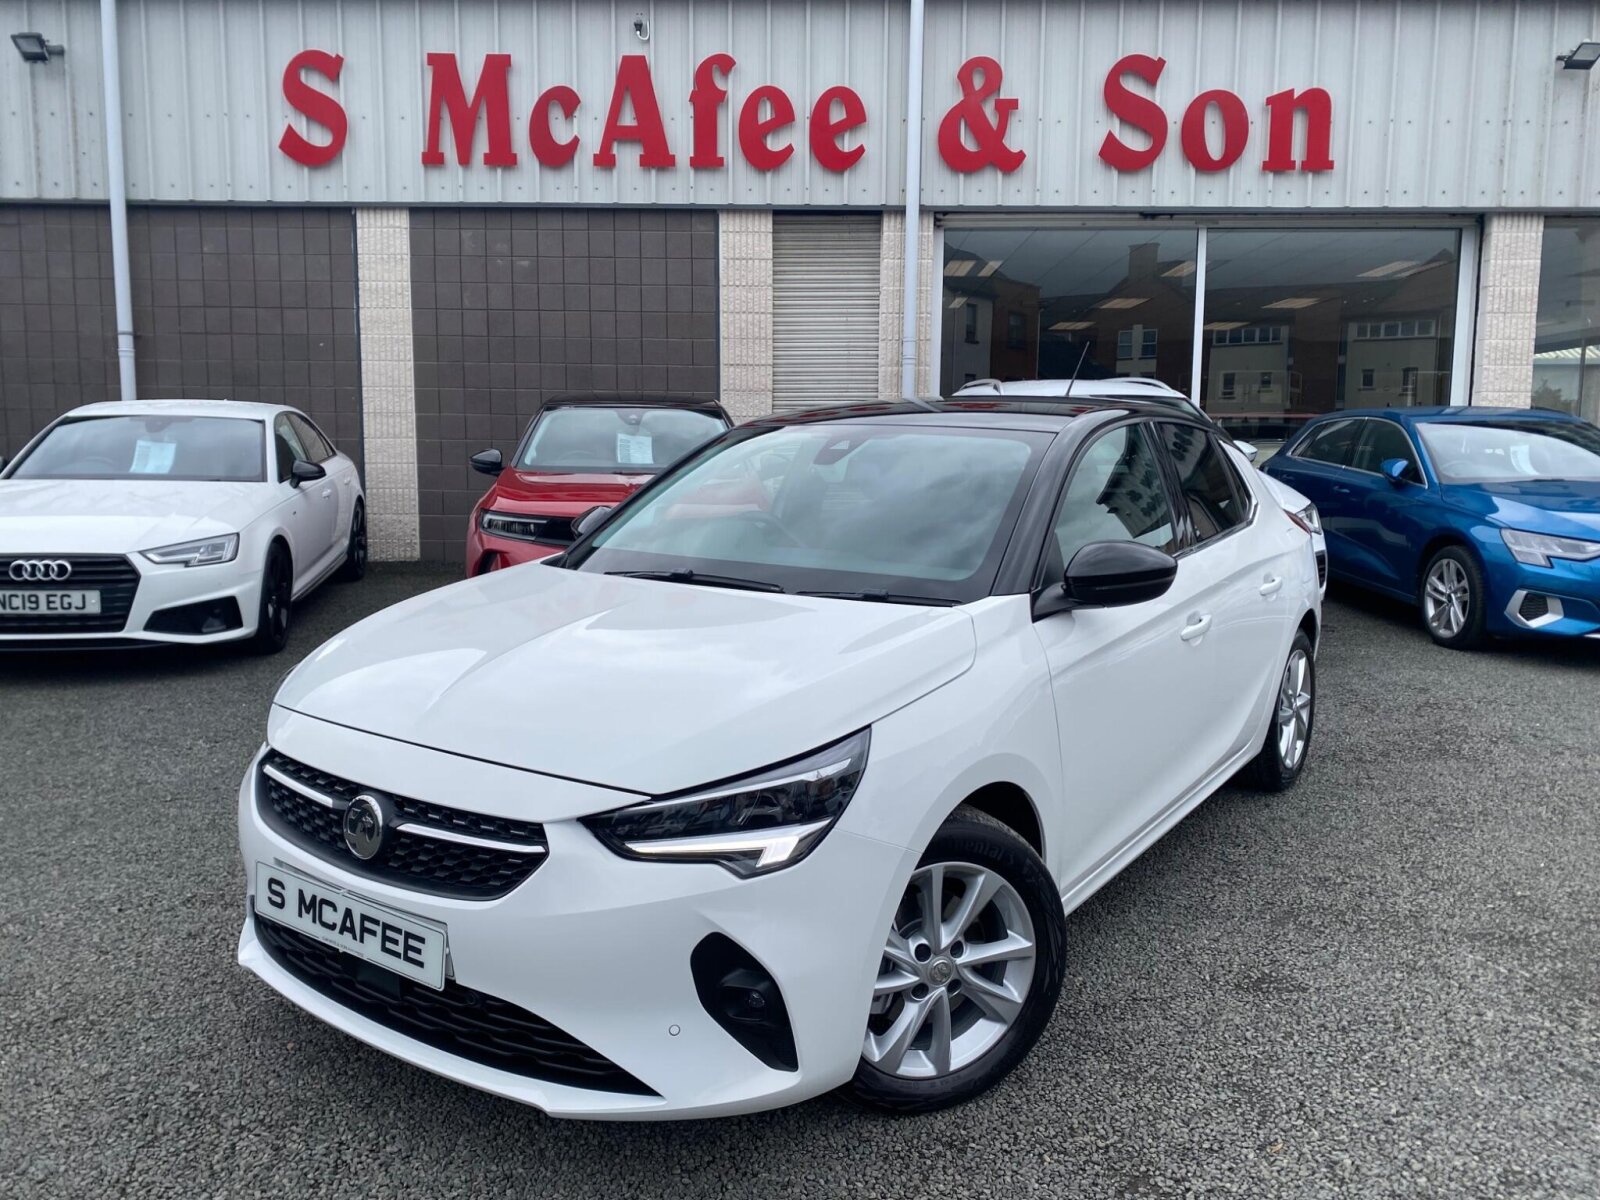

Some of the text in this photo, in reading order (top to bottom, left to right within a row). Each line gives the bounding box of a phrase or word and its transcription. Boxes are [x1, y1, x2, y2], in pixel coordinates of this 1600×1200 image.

[280, 50, 1335, 173] S McAfee & Son
[45, 593, 86, 611] EGJ
[267, 876, 286, 910] S
[297, 888, 427, 970] MCAFEE
